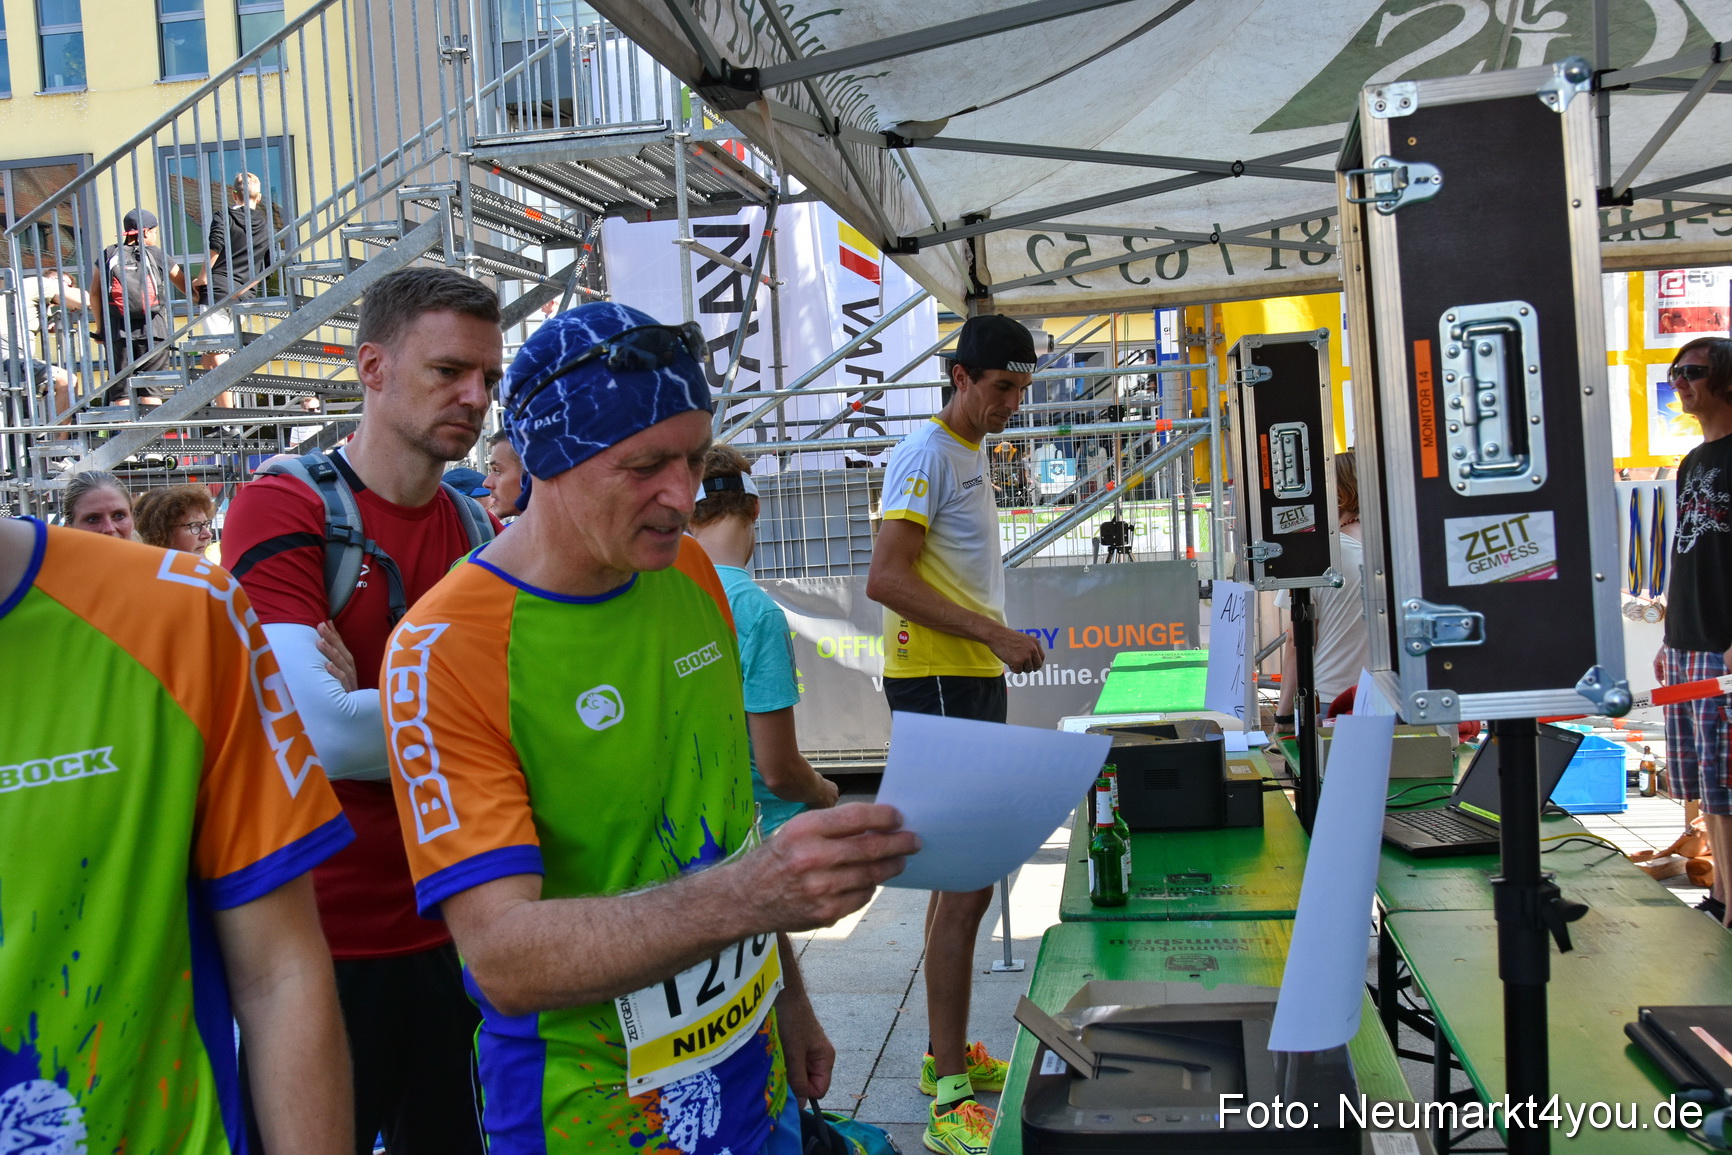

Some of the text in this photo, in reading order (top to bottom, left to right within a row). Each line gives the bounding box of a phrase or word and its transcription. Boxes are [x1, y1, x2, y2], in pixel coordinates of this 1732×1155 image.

[534, 410, 562, 430] PAC
[1418, 370, 1434, 448] MONITOR 14
[903, 477, 929, 499] 20
[1277, 505, 1306, 525] ZEIT
[1458, 513, 1530, 562] ZEIT
[1068, 622, 1185, 649] LOUNGE
[674, 641, 723, 678] BOCK
[386, 621, 461, 844] BOCK
[0, 746, 119, 793] BOCK
[674, 974, 765, 1057] NIKOLAI
